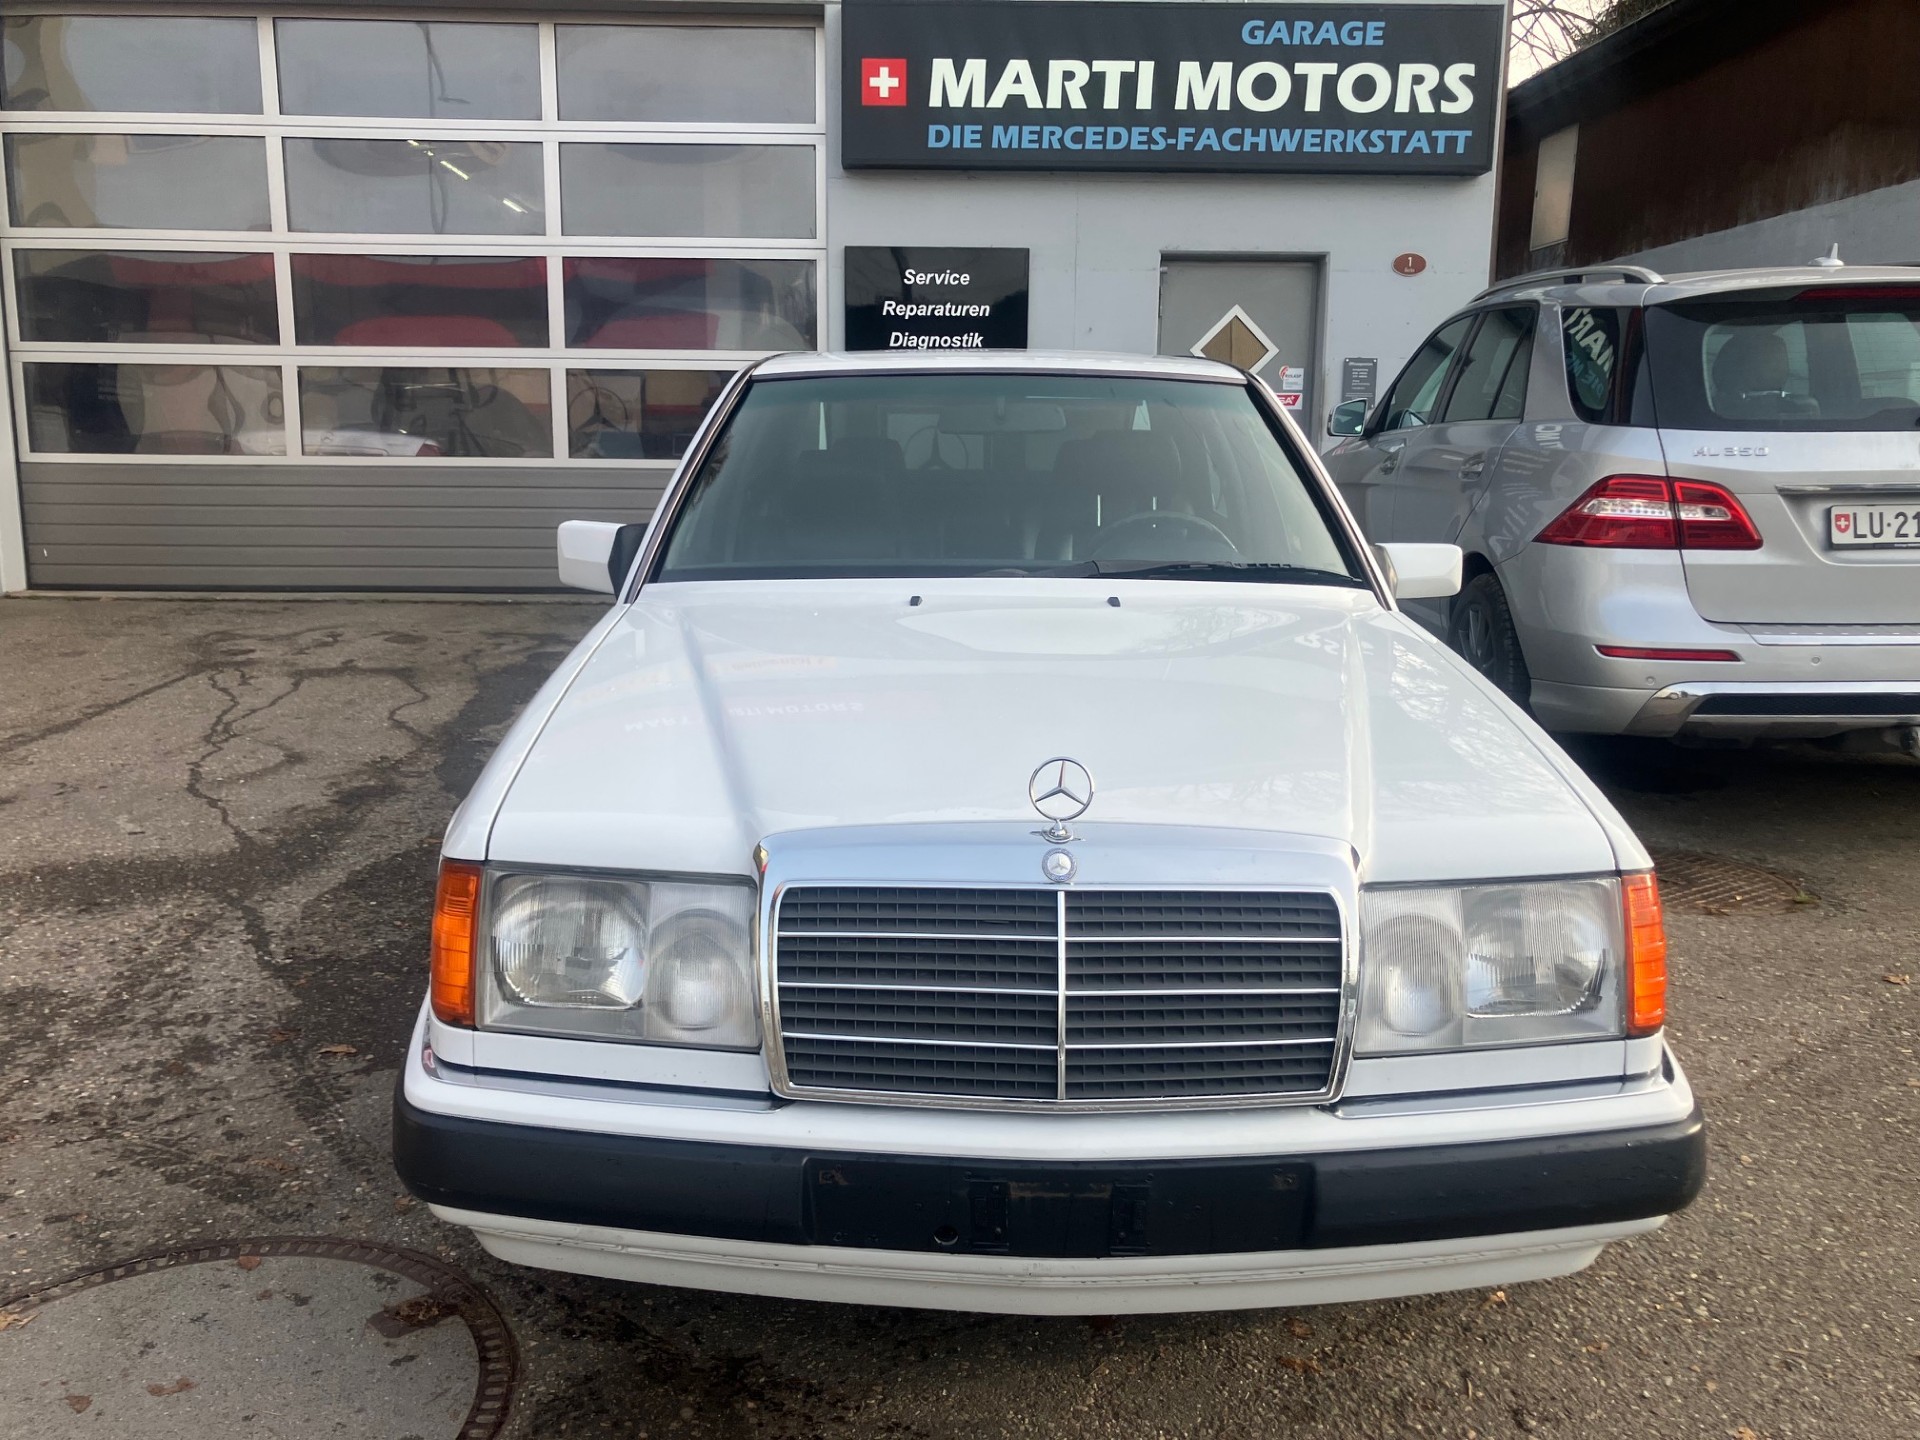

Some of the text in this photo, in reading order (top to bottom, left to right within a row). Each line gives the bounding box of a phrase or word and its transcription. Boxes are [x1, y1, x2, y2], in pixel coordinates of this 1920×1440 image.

[1241, 20, 1386, 46] GARAGE
[928, 58, 1476, 114] MARTI MOTORS
[927, 124, 1473, 154] DIE MERCEDES-FACHWERKSTATT
[1407, 256, 1412, 268] 1
[903, 268, 971, 286] Service
[882, 300, 991, 320] Reparaturen
[889, 332, 984, 350] Diagnostik
[1693, 446, 1769, 457] ML 350
